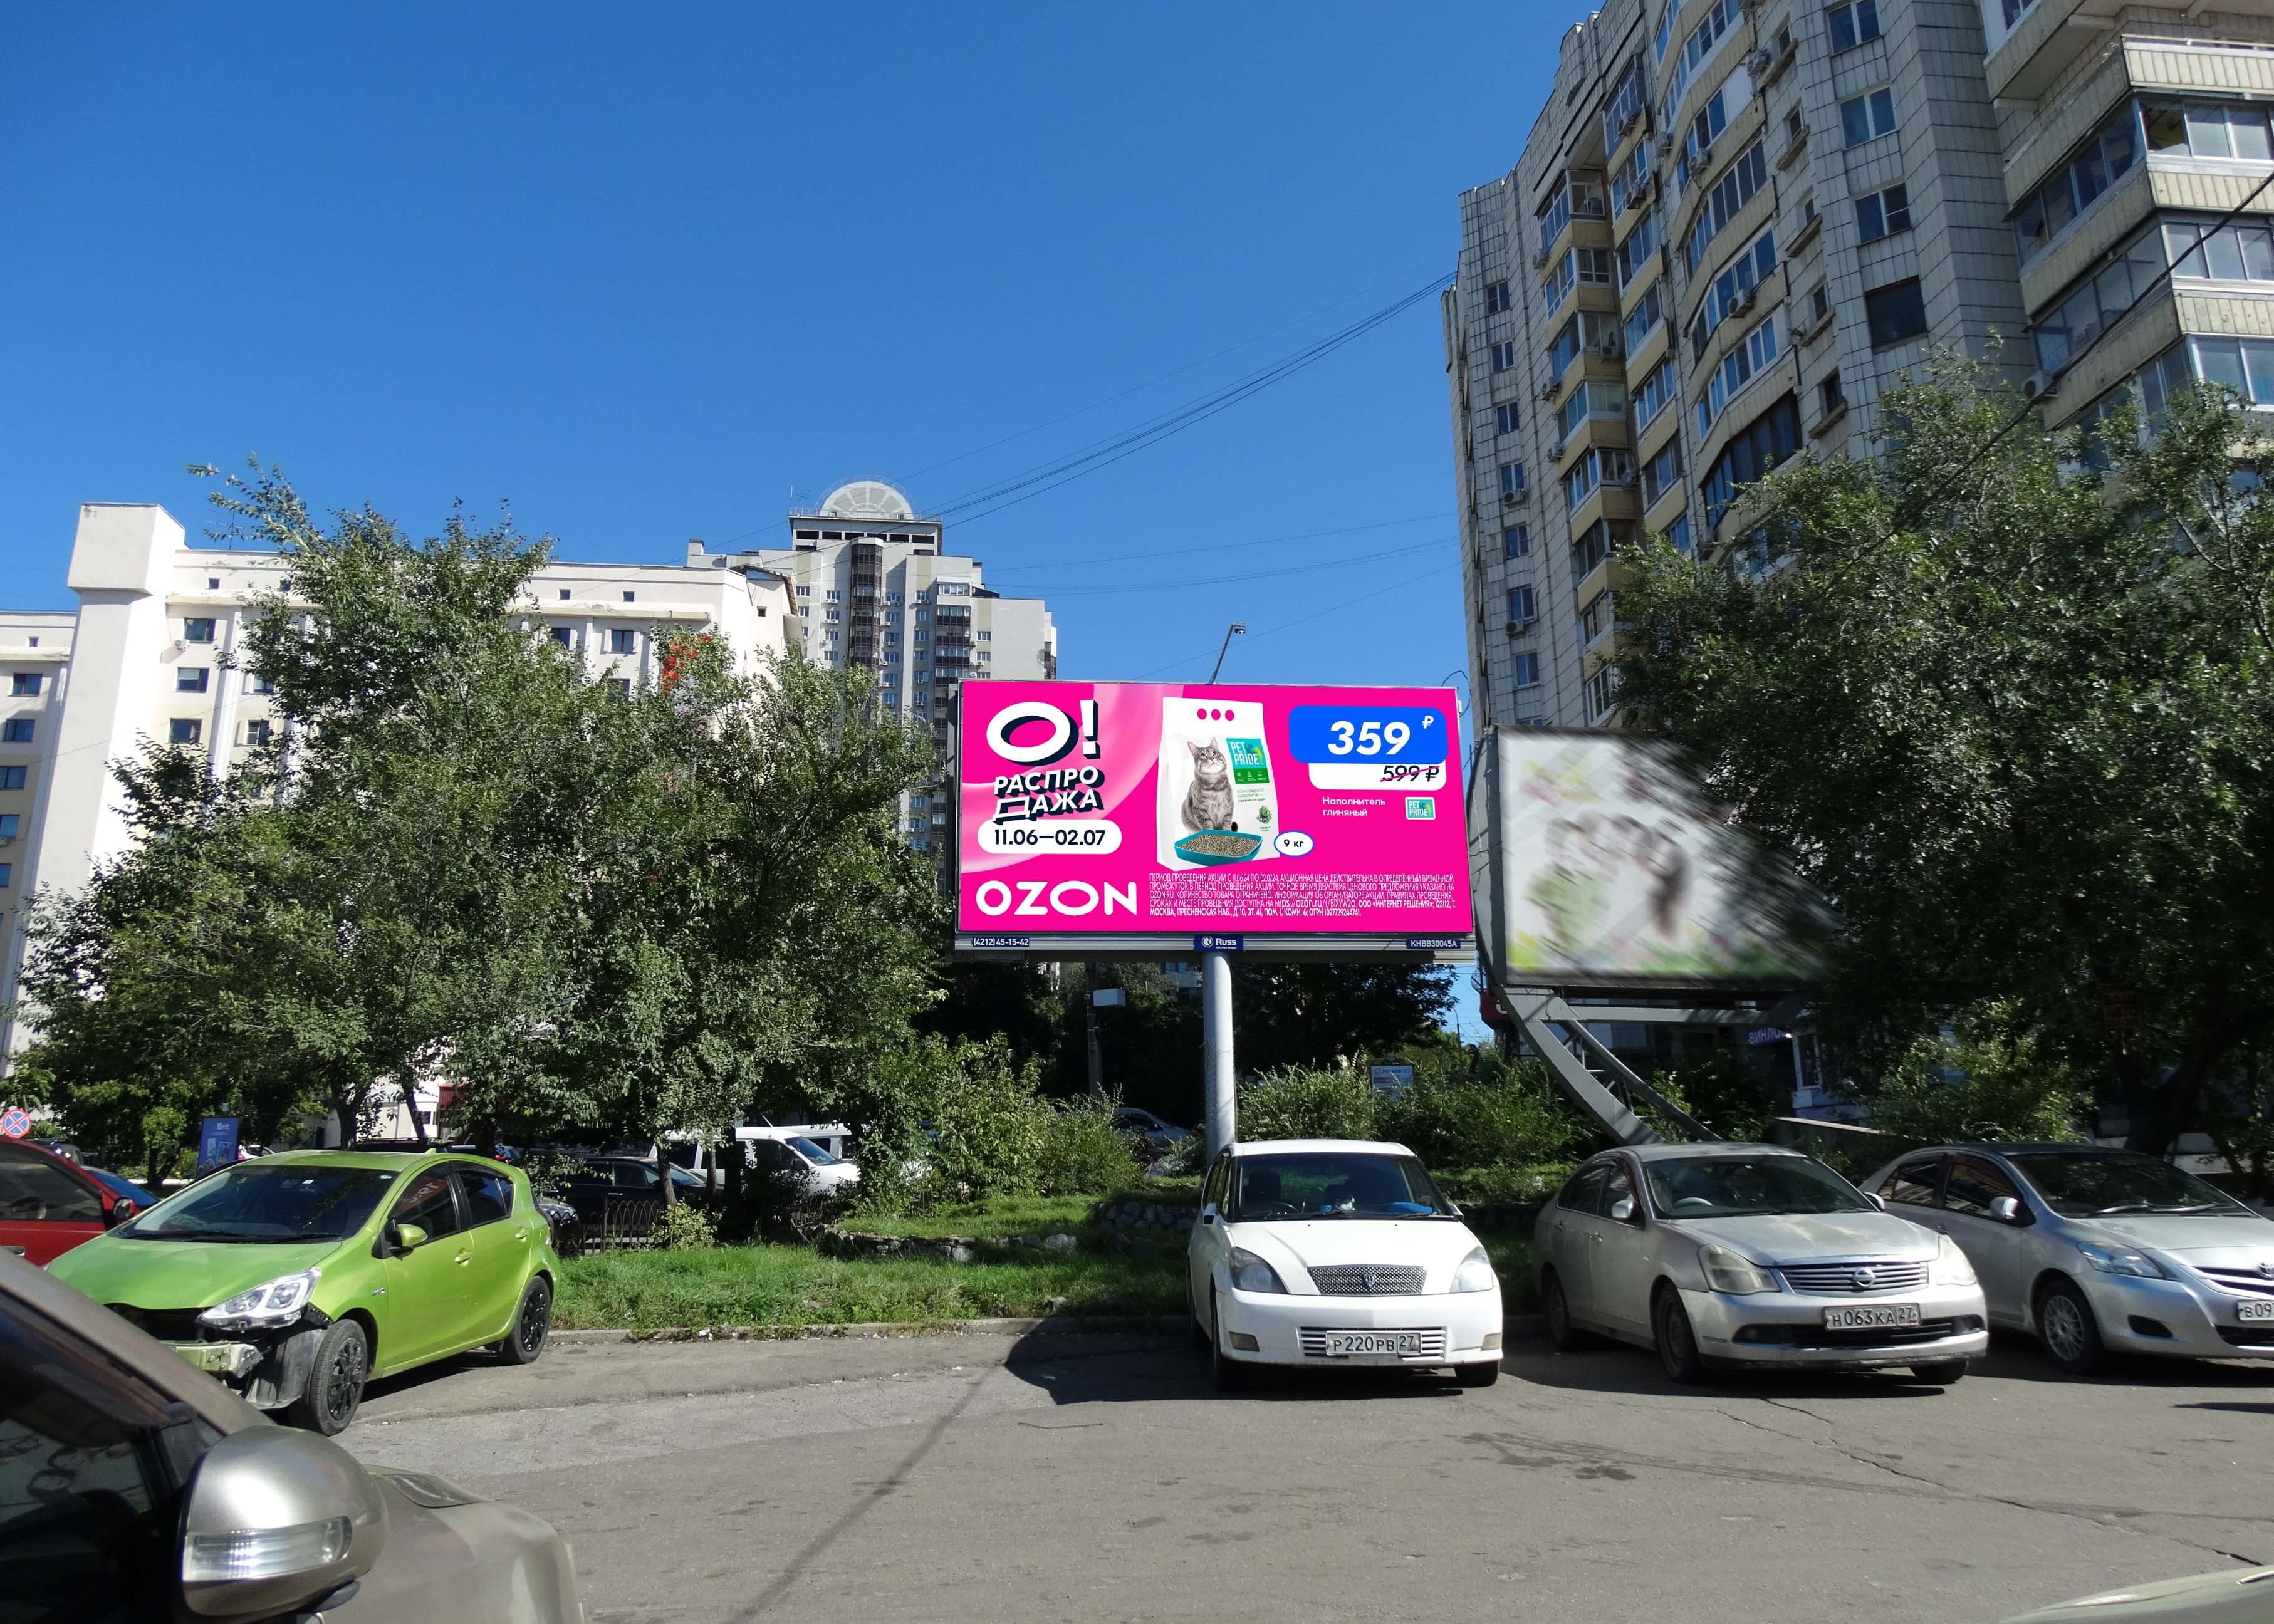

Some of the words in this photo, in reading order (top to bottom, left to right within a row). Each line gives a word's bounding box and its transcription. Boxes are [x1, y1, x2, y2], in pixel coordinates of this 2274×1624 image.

[1328, 721, 1411, 756] 359
[1230, 741, 1246, 754] PET
[1234, 753, 1260, 766] PRIDE
[1382, 765, 1420, 782] 599
[994, 766, 1105, 798] РАСПРО
[1322, 797, 1386, 806] Наполнитель
[993, 789, 1104, 825] ДАЖА
[1323, 809, 1368, 817] глиняный
[1409, 808, 1428, 816] PRIDE
[1283, 839, 1290, 848] 9
[1149, 873, 1171, 882] ПЕРИОД
[1172, 873, 1206, 882] ПРОВЕДЕНИЯ
[1208, 873, 1226, 882] АКЦИИ
[1280, 874, 1313, 883] АКЦИОННАЯ
[1316, 874, 1328, 883] ЦЕНА
[1330, 873, 1373, 883] ДЕЙСТВИТЕЛЬНА
[1422, 874, 1454, 883] ВРЕМЕННОЙ
[1195, 882, 1216, 890] ПЕРИОД
[1218, 882, 1253, 890] ПРОВЕДЕНИЯ
[1318, 882, 1345, 891] ДЕЙСТВИЯ
[1348, 883, 1377, 891] ЦЕНОВОГО
[1379, 883, 1418, 891] ПРЕДЛОЖЕНИЯ
[976, 880, 1137, 916] OZON
[1275, 891, 1313, 899] ИНФОРМАЦИЯ
[1198, 899, 1233, 907] ПРОВЕДЕНИЯ
[1235, 900, 1264, 908] ДОСТУПНА
[1150, 908, 1176, 917] МОСКВА,
[1177, 908, 1217, 916] ПРЕСНЕНСКАЯ
[1264, 908, 1278, 916] ПОМ.
[1309, 908, 1323, 916] ОГРН
[1216, 938, 1237, 946] Russ
[217, 1122, 231, 1130] Brit
[2245, 1303, 2274, 1318] В09
